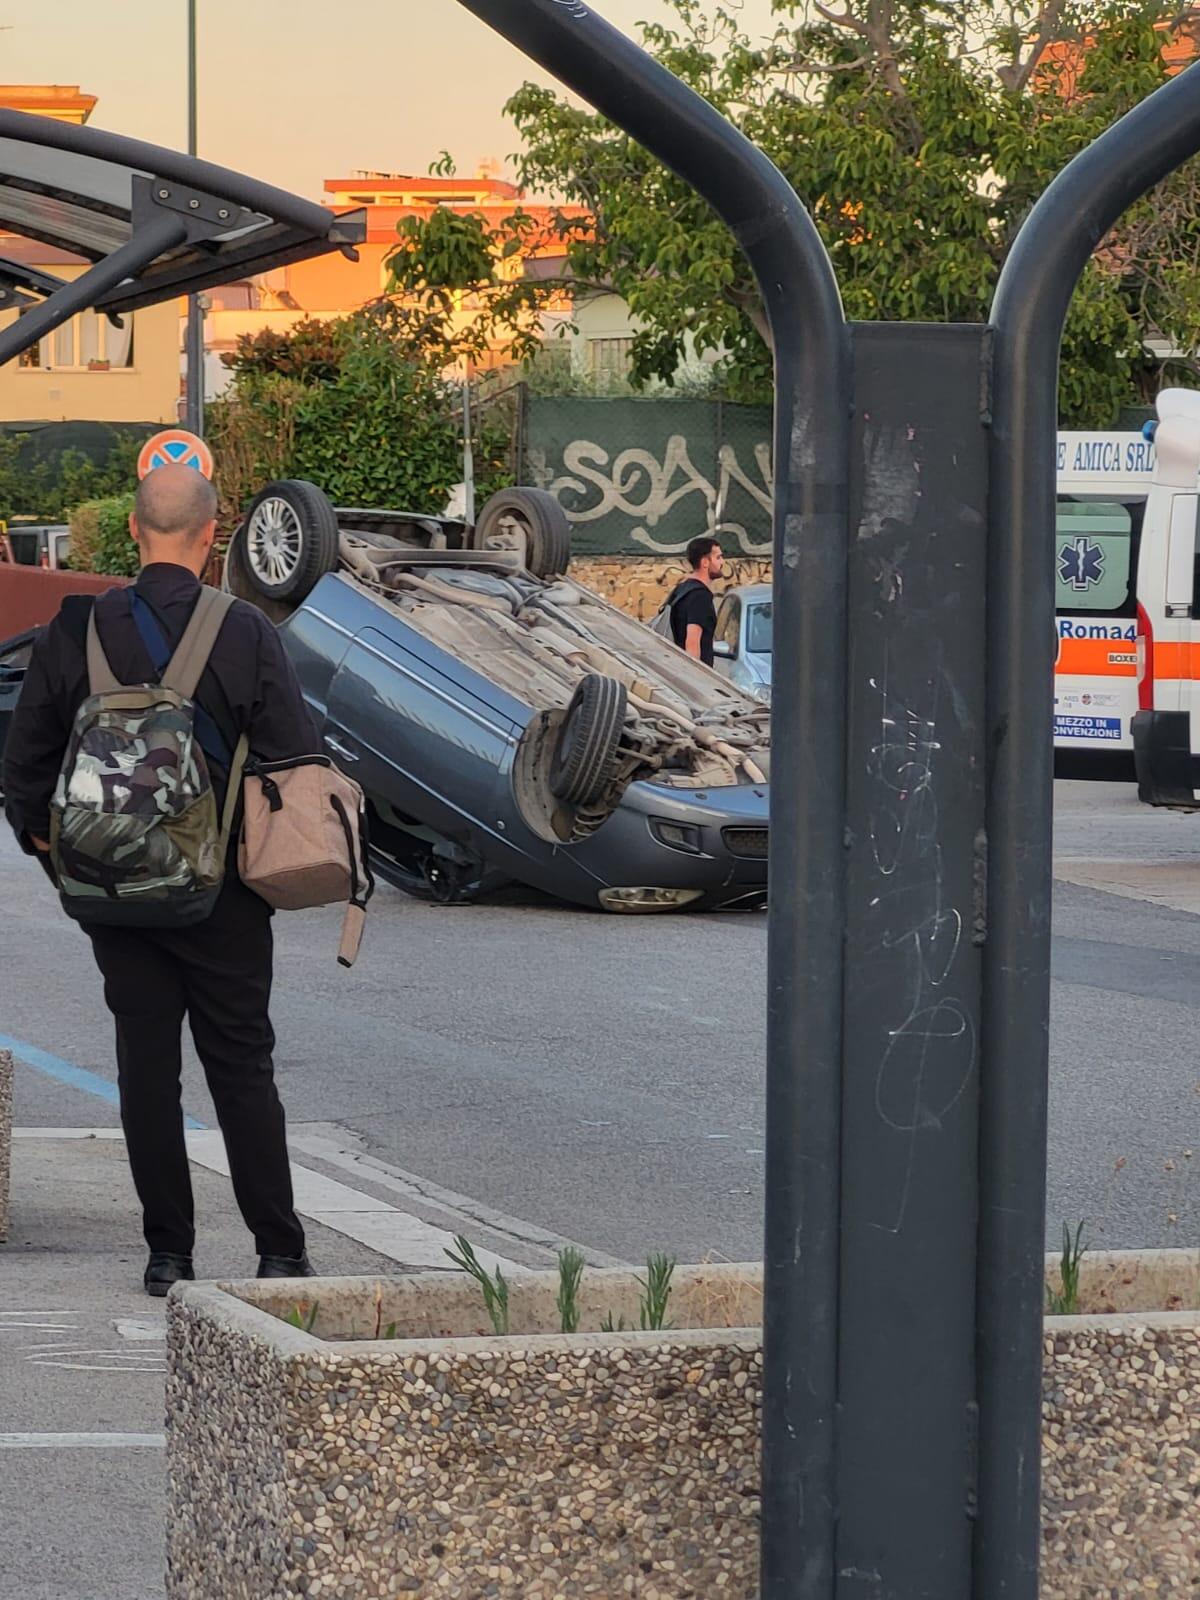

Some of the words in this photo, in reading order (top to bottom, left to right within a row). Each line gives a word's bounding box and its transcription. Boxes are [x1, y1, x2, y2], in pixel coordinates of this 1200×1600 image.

[1073, 442, 1121, 472] AMICA
[1125, 442, 1155, 472] SRL
[1056, 716, 1093, 727] MEZZO
[1096, 719, 1107, 729] IN
[1053, 726, 1121, 738] ONVENZIONE
